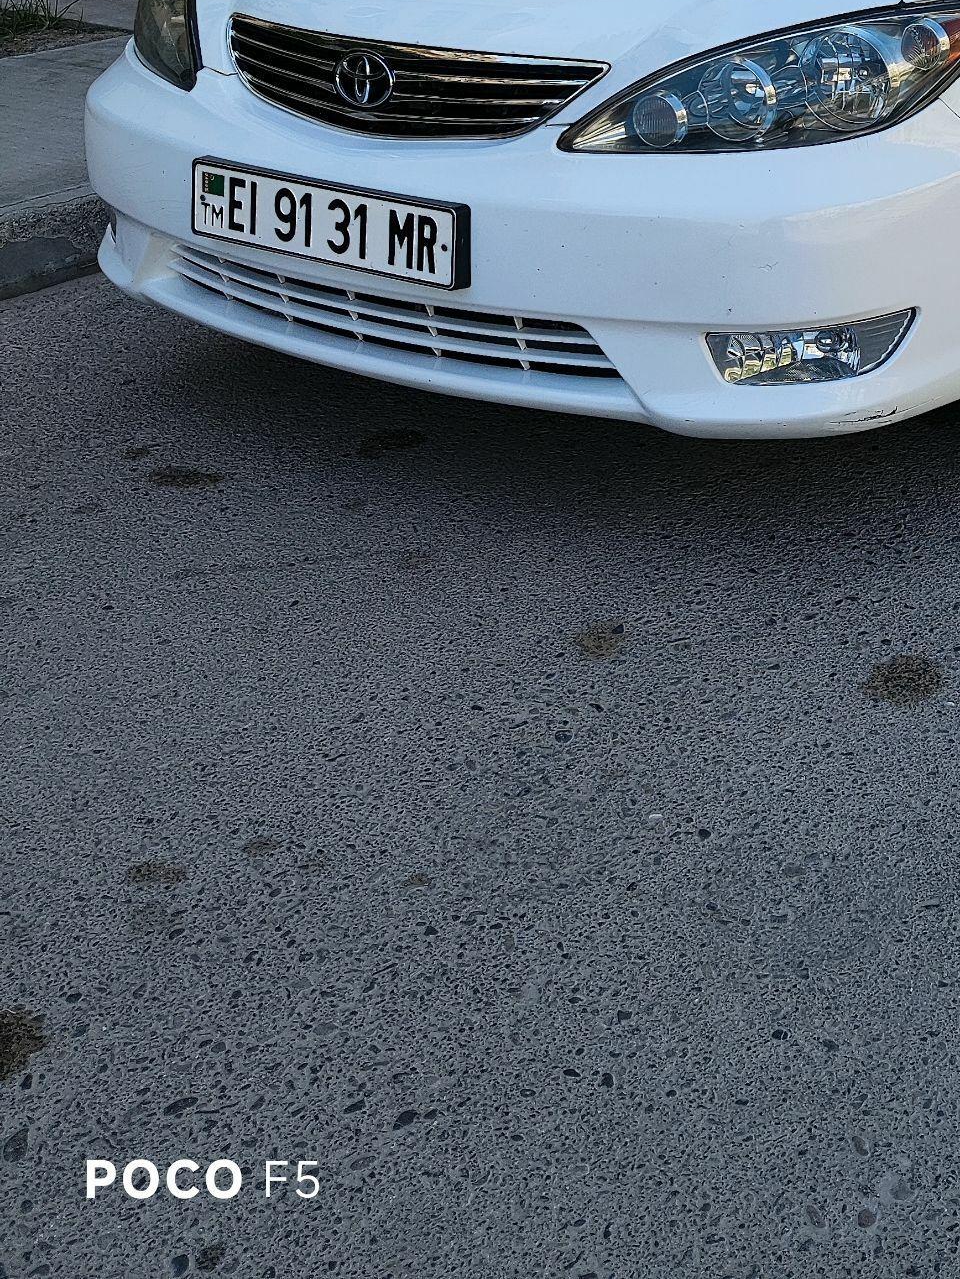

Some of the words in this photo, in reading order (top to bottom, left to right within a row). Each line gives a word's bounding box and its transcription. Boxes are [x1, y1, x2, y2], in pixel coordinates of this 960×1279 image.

[201, 201, 224, 229] TM
[228, 176, 257, 236] EI
[274, 187, 313, 248] 91
[326, 198, 368, 260] 31
[387, 208, 438, 275] MR
